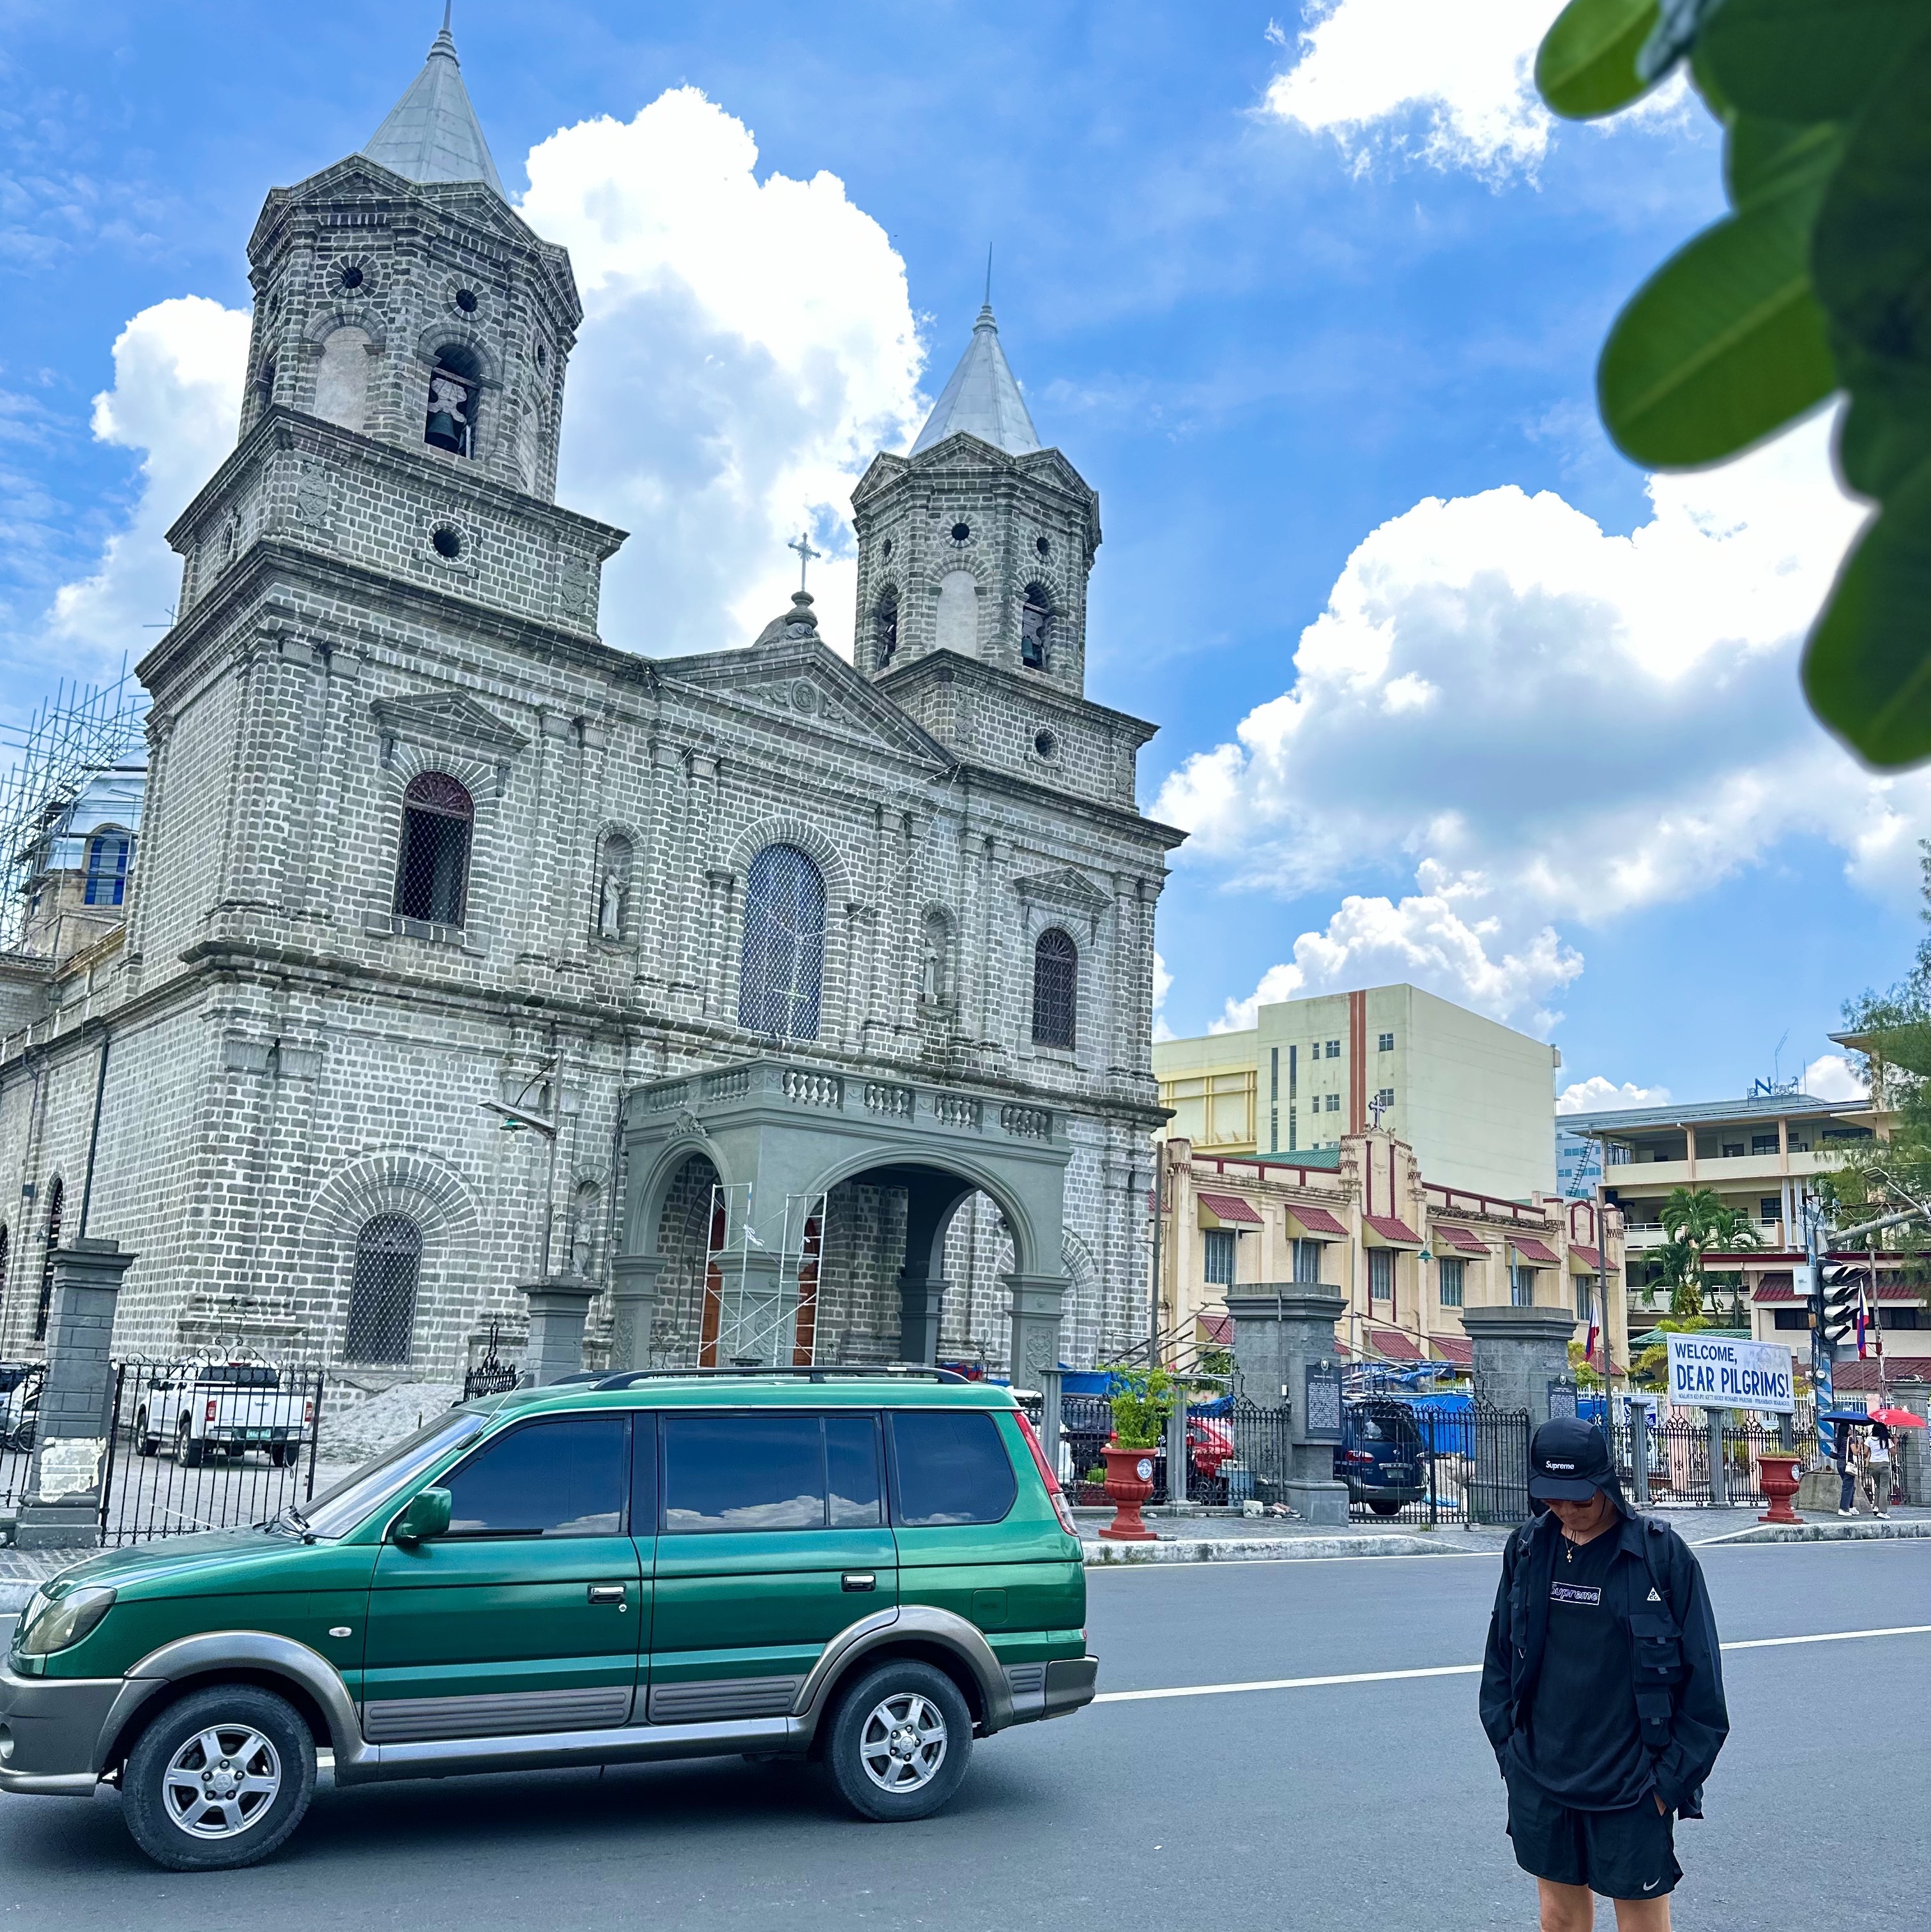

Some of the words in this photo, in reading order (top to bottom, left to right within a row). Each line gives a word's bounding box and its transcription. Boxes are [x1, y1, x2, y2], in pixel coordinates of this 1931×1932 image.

[1674, 1343, 1737, 1365] WELCOME,
[1677, 1364, 1714, 1392] DEAR
[1721, 1367, 1790, 1398] PILGRIMS!
[1546, 1460, 1575, 1470] Supreme
[1550, 1583, 1598, 1601] Supreme
